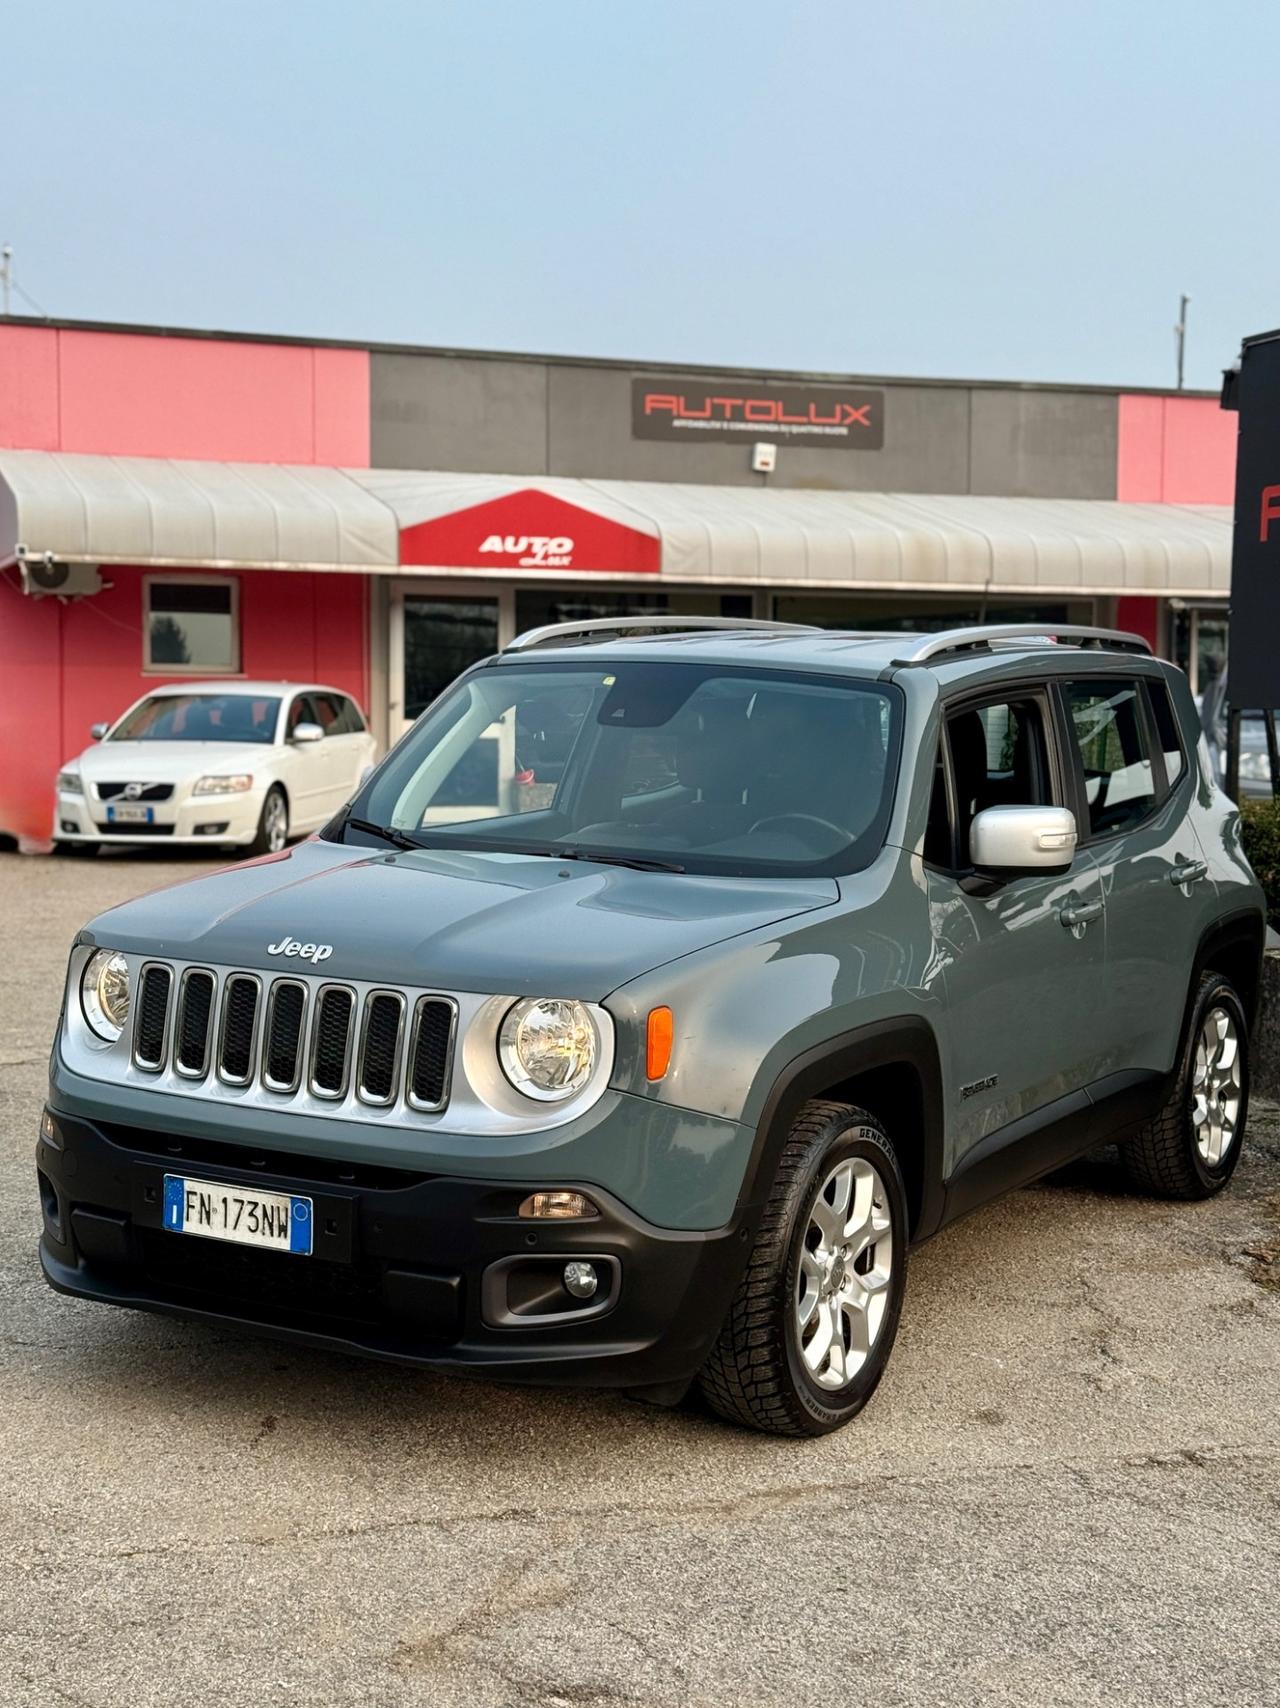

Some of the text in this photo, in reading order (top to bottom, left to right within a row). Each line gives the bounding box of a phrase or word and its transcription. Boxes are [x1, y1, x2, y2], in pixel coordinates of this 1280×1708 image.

[644, 394, 871, 427] AUTOLUX
[478, 535, 574, 554] AUTO
[267, 936, 333, 964] Jeep
